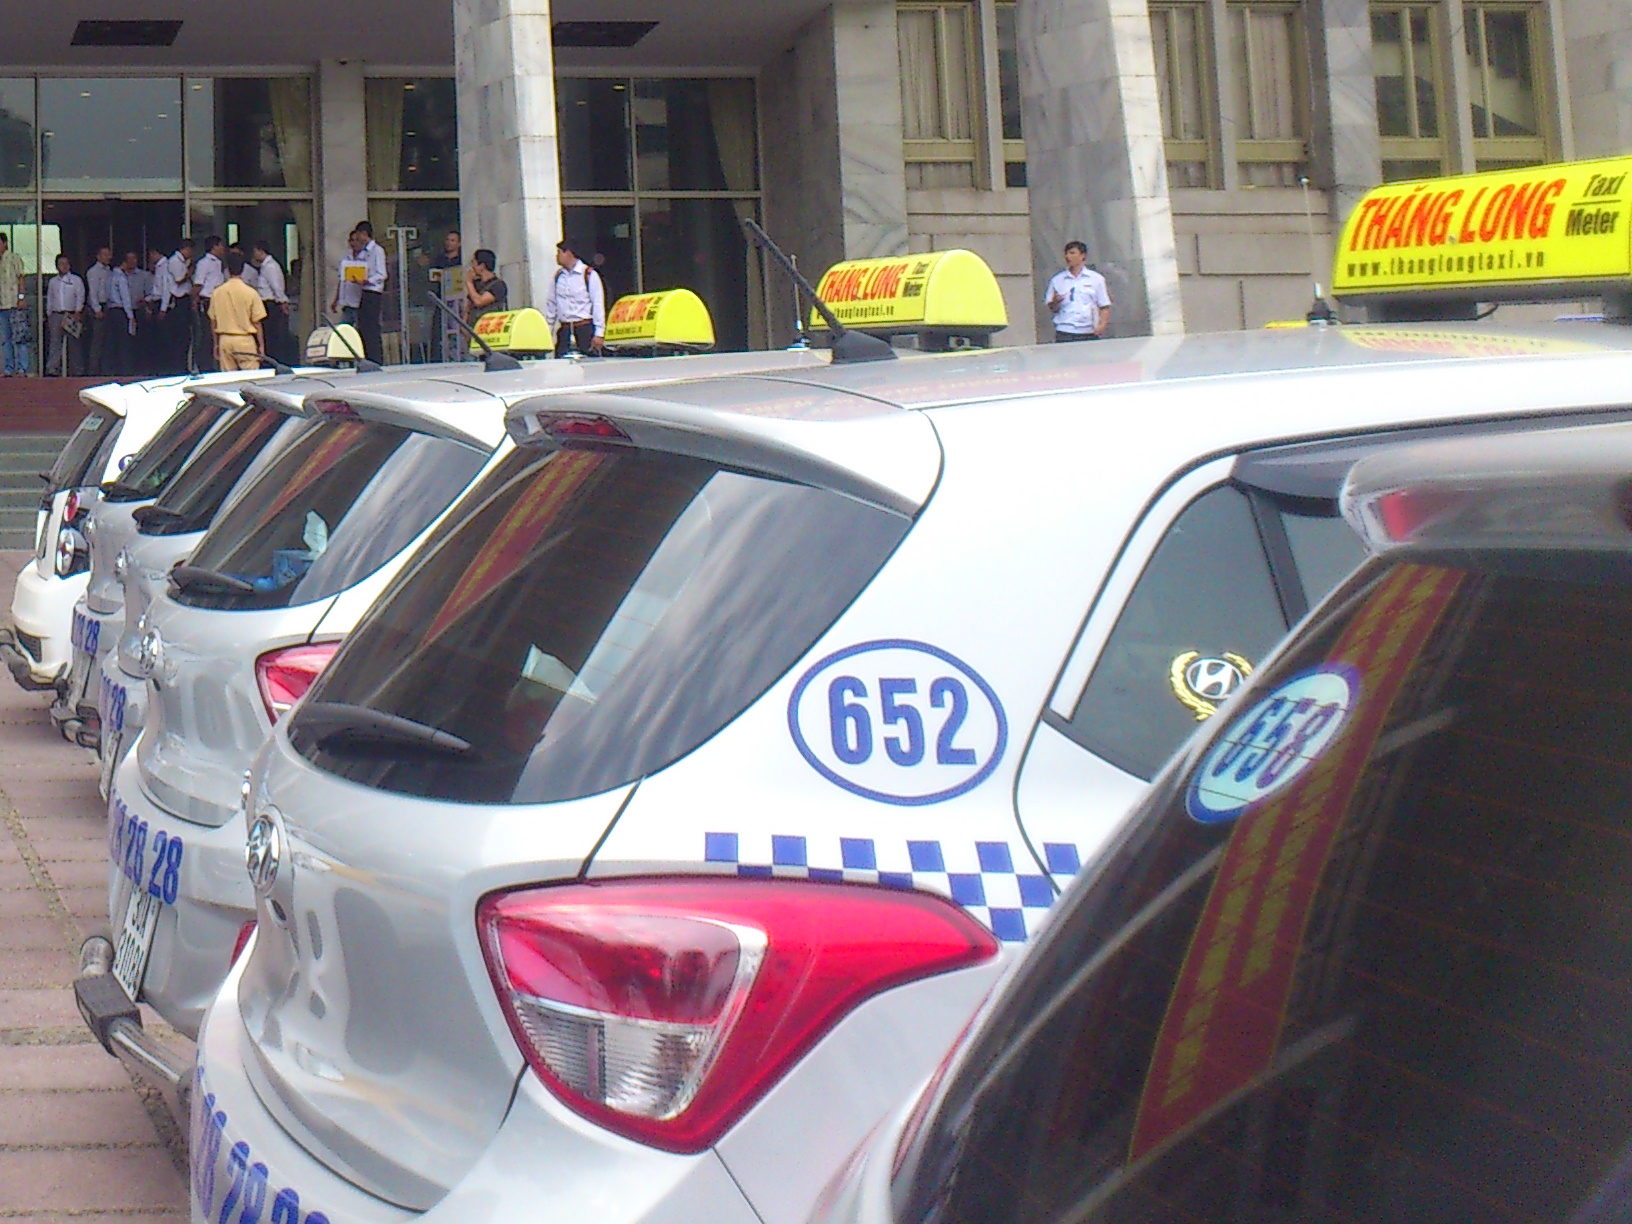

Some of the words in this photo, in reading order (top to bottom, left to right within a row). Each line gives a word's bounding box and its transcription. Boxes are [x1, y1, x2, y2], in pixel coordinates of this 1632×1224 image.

[1583, 171, 1629, 198] Taxi
[1458, 178, 1567, 244] LONG
[1565, 207, 1619, 237] Meter
[862, 263, 909, 300] LONG
[1347, 250, 1545, 278] www.thanglongtaxi.vn
[829, 676, 976, 766] 652
[1211, 695, 1339, 789] 658
[149, 830, 183, 905] 28
